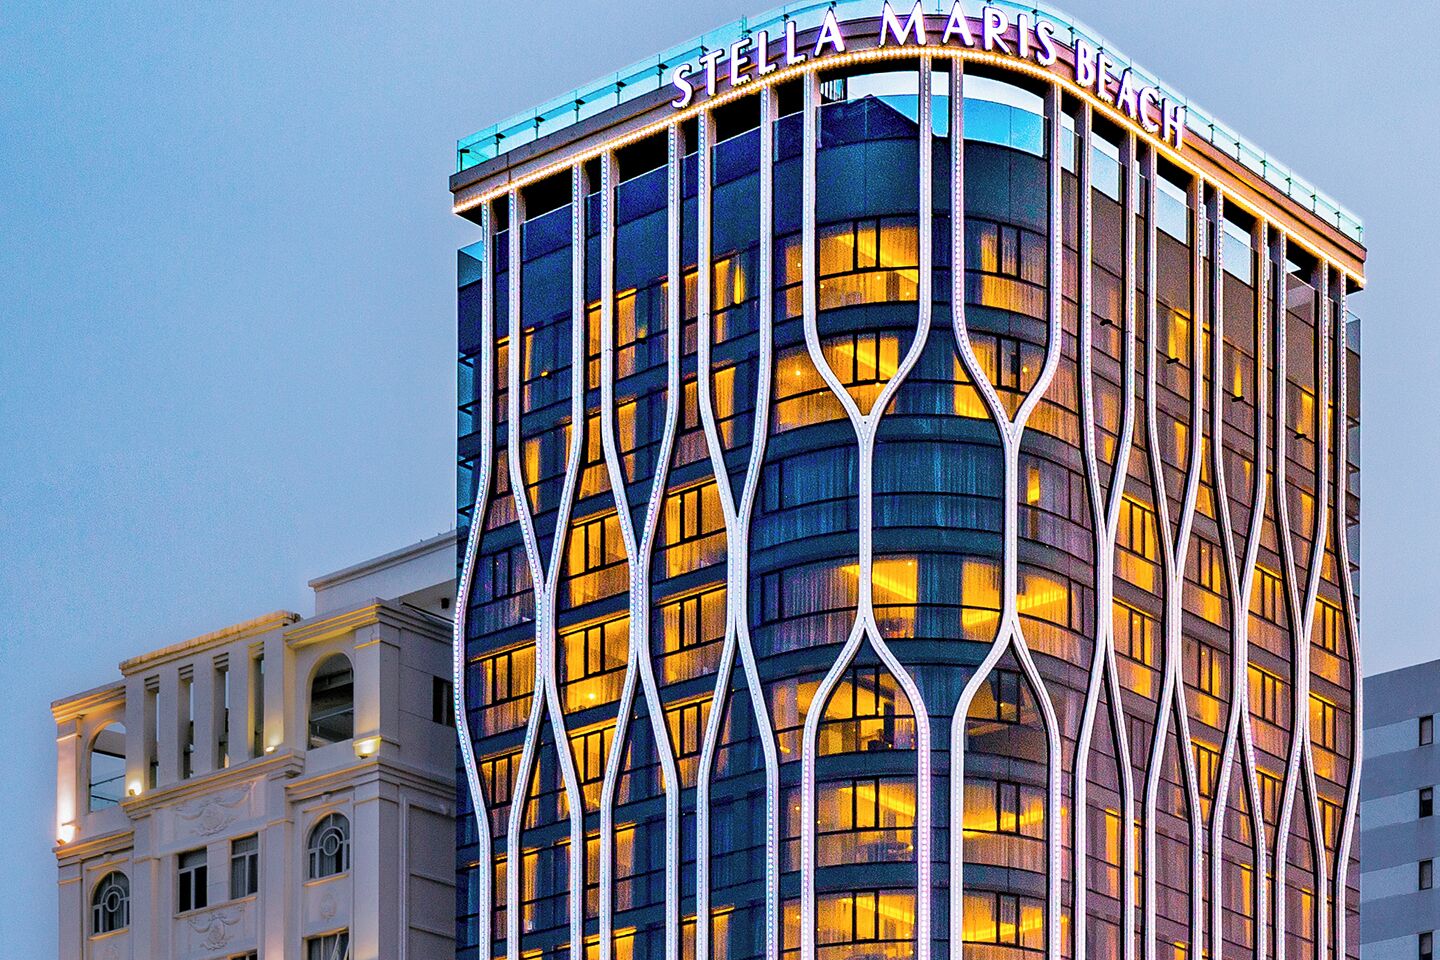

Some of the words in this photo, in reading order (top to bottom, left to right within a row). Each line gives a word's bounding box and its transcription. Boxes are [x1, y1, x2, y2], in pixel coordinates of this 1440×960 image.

[672, 7, 846, 108] STELLA
[878, 0, 1057, 67] MARIS
[1073, 39, 1184, 150] BEACH
